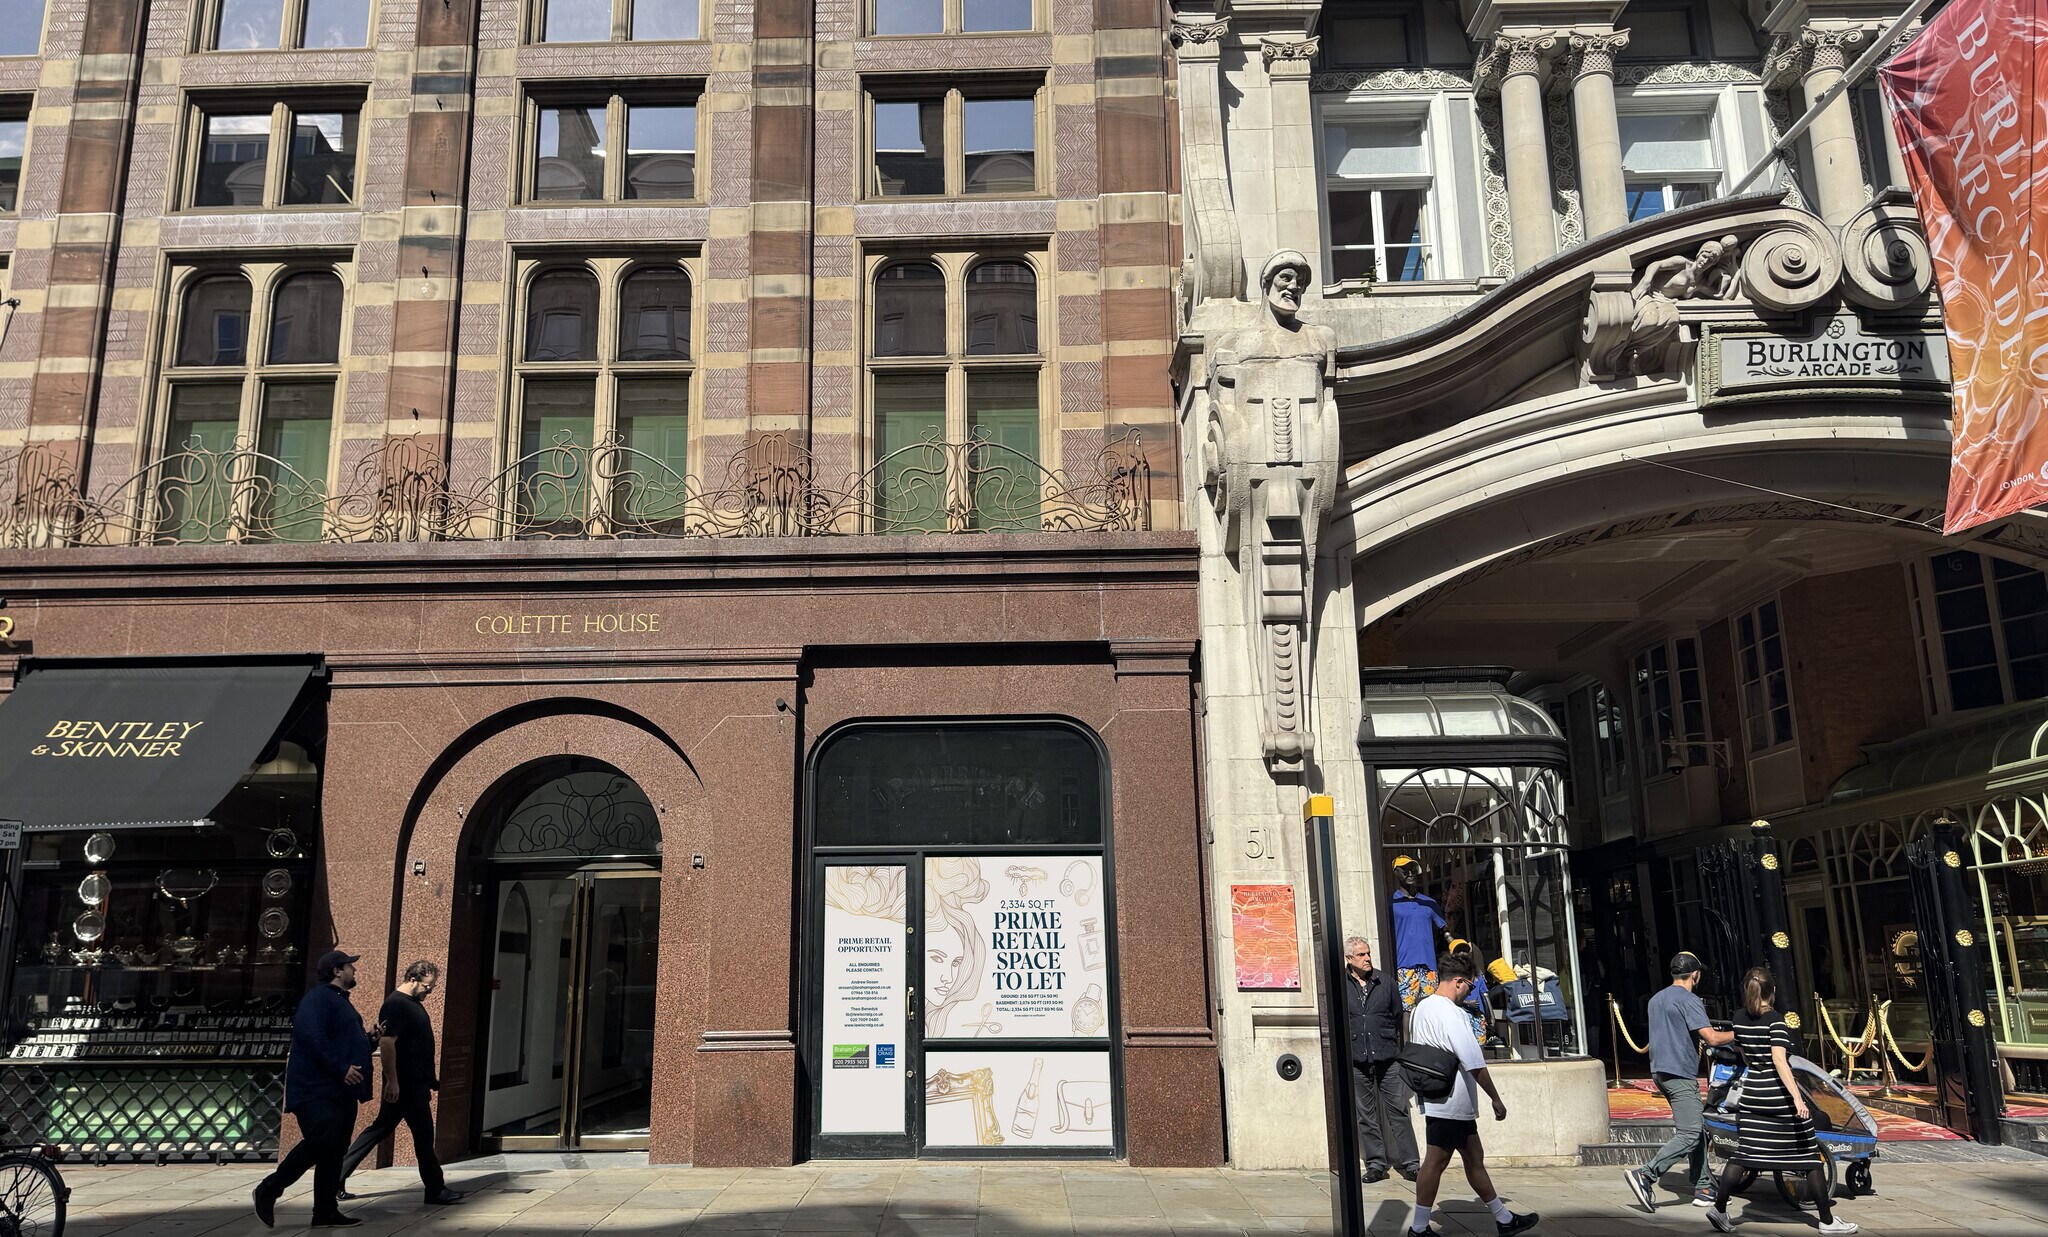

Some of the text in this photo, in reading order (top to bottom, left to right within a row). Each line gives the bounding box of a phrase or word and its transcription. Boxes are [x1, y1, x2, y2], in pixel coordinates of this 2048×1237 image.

[1946, 128, 2024, 370] ARCADE
[1746, 341, 1926, 366] BURLINGTON
[1797, 363, 1872, 377] ARCADE
[2000, 472, 2034, 491] LONDON
[475, 614, 660, 634] COLETTE HOUSE
[45, 720, 204, 740] BENTLEY
[31, 740, 182, 758] & SKINNER
[1245, 826, 1275, 859] 51
[1000, 900, 1055, 910] 2,334 SQ FT
[994, 912, 1062, 929] PRIME
[992, 932, 1066, 949] RETAIL
[997, 952, 1061, 970] SPACE
[992, 972, 1066, 990] TO LET
[90, 1044, 147, 1054] BENTLEY
[158, 1044, 216, 1054] SKINNER
